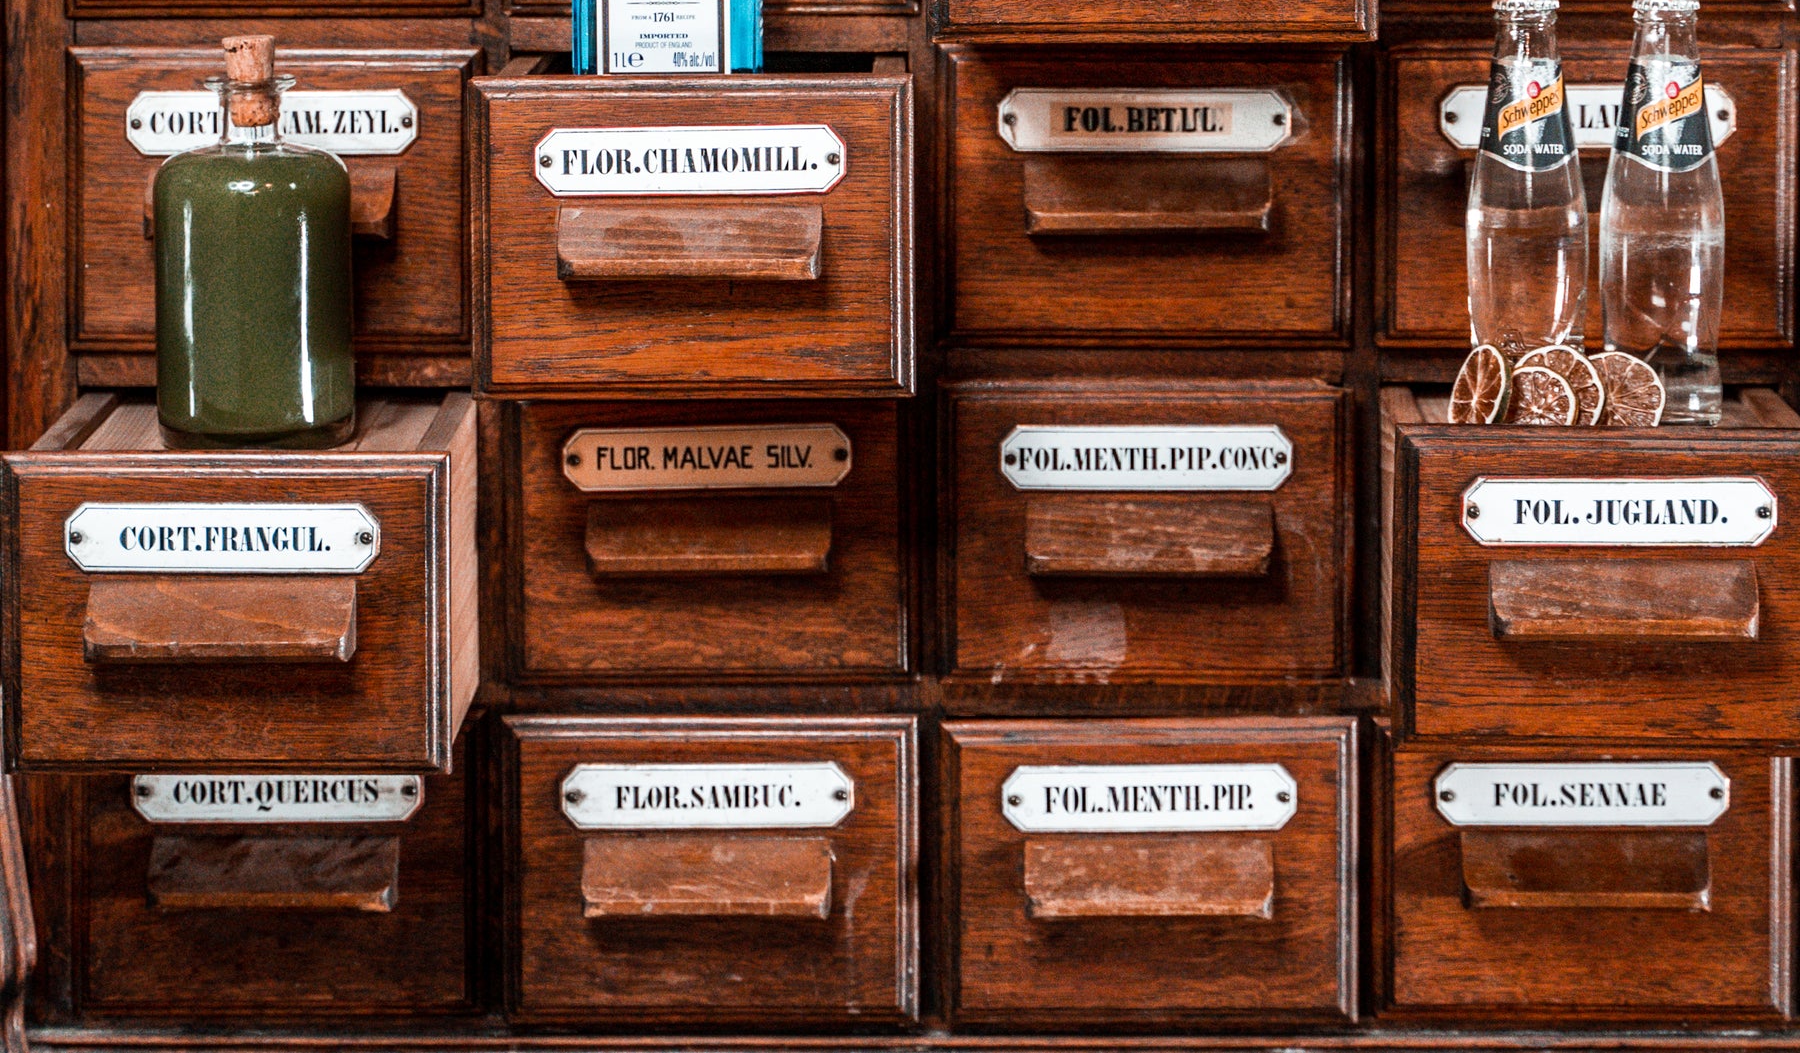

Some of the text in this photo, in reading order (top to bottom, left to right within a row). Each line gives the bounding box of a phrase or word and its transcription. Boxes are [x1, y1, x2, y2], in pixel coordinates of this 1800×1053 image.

[653, 12, 675, 23] 1761
[673, 52, 688, 68] 40%
[1502, 91, 1560, 129] Schweppes
[1640, 90, 1700, 129] Schweppes
[1503, 144, 1564, 155] SODA WATER
[1641, 145, 1703, 156] SODA WATER
[597, 444, 812, 471] FLOR. MALVAE SILV.
